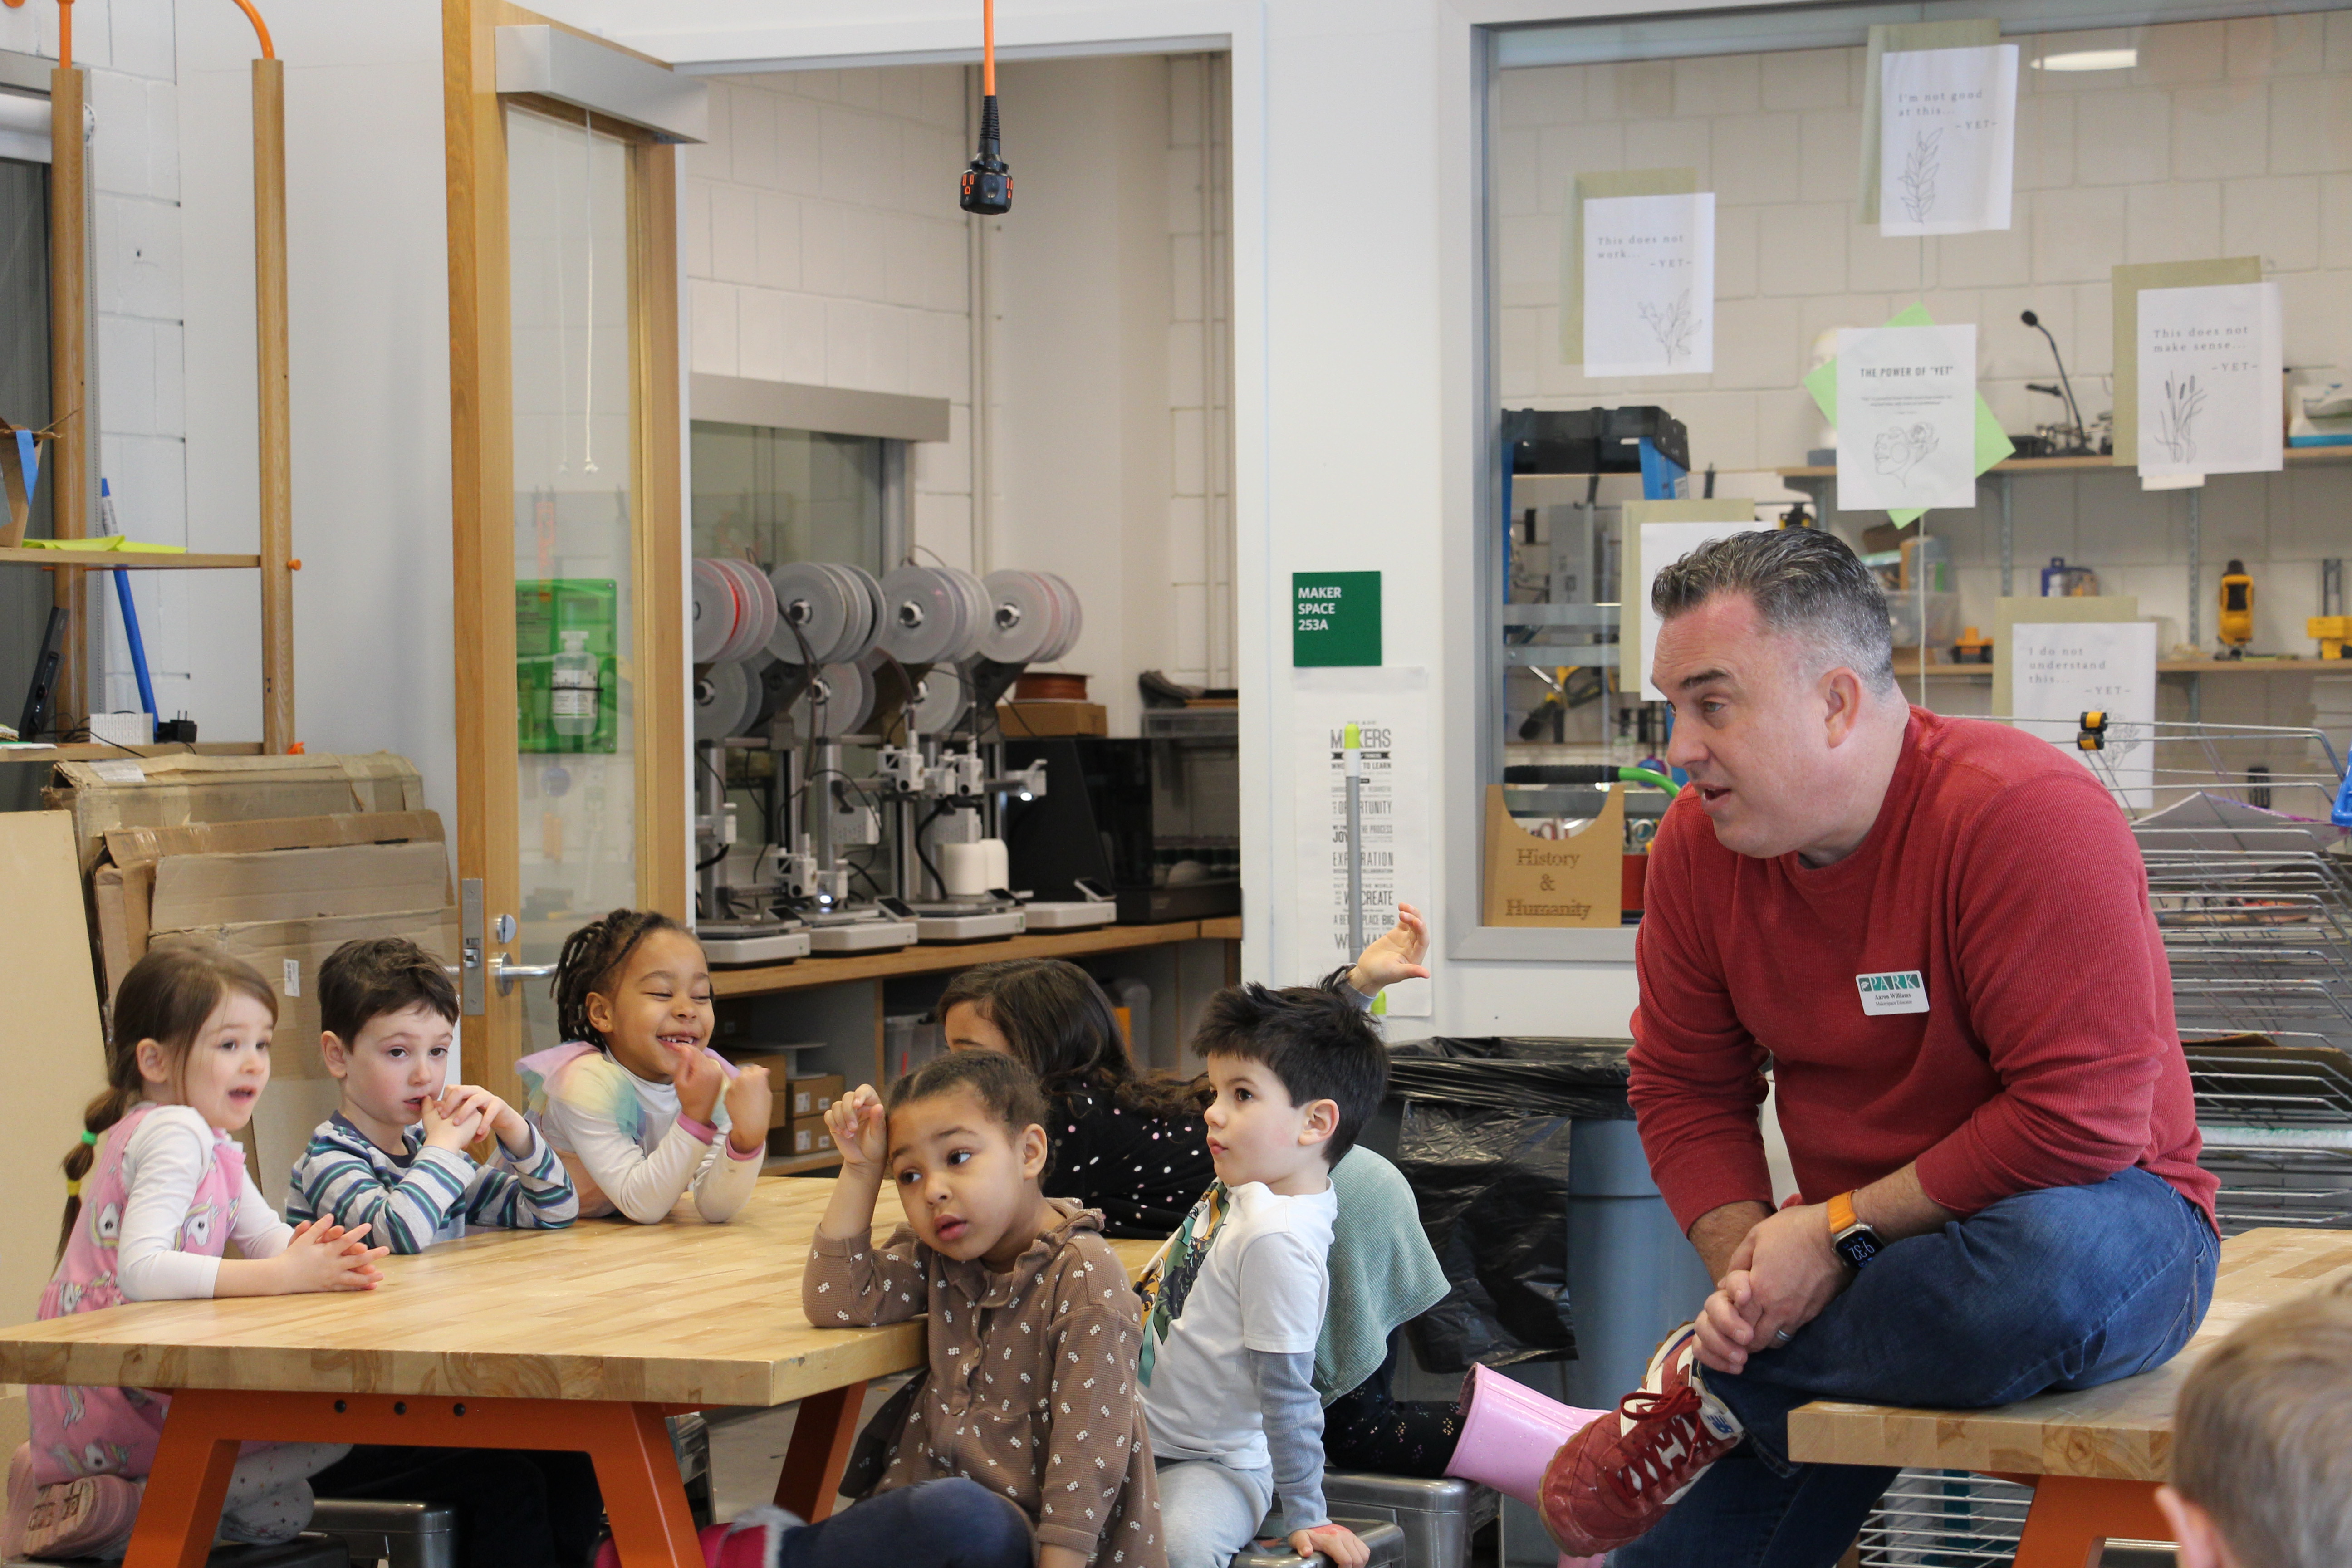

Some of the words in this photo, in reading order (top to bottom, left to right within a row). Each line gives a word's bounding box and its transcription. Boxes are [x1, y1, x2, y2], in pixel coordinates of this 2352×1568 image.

[1899, 93, 1918, 103] I'm
[1925, 93, 1945, 102] not
[1951, 90, 1982, 103] good
[1598, 237, 1623, 245] This
[1628, 235, 1656, 244] does
[1663, 235, 1683, 243] not
[2154, 328, 2181, 338] This
[2188, 327, 2219, 337] does
[2226, 326, 2248, 335] not
[2154, 342, 2186, 352] make
[1861, 368, 1877, 377] THE
[1881, 367, 1911, 377] POWER
[1915, 367, 1926, 376] OF
[1298, 586, 1342, 598] MAKER
[1298, 603, 1336, 615] SPACE
[1298, 618, 1329, 631] 253A
[2039, 646, 2056, 656] do
[2062, 647, 2083, 656] not
[2029, 660, 2106, 669] understand
[1331, 729, 1391, 748] MERS
[1333, 851, 1393, 866] EXPRATION
[1516, 848, 1581, 869] History
[1539, 873, 1556, 892] &
[1505, 898, 1592, 920] Humanity
[1868, 974, 1918, 992] PARK
